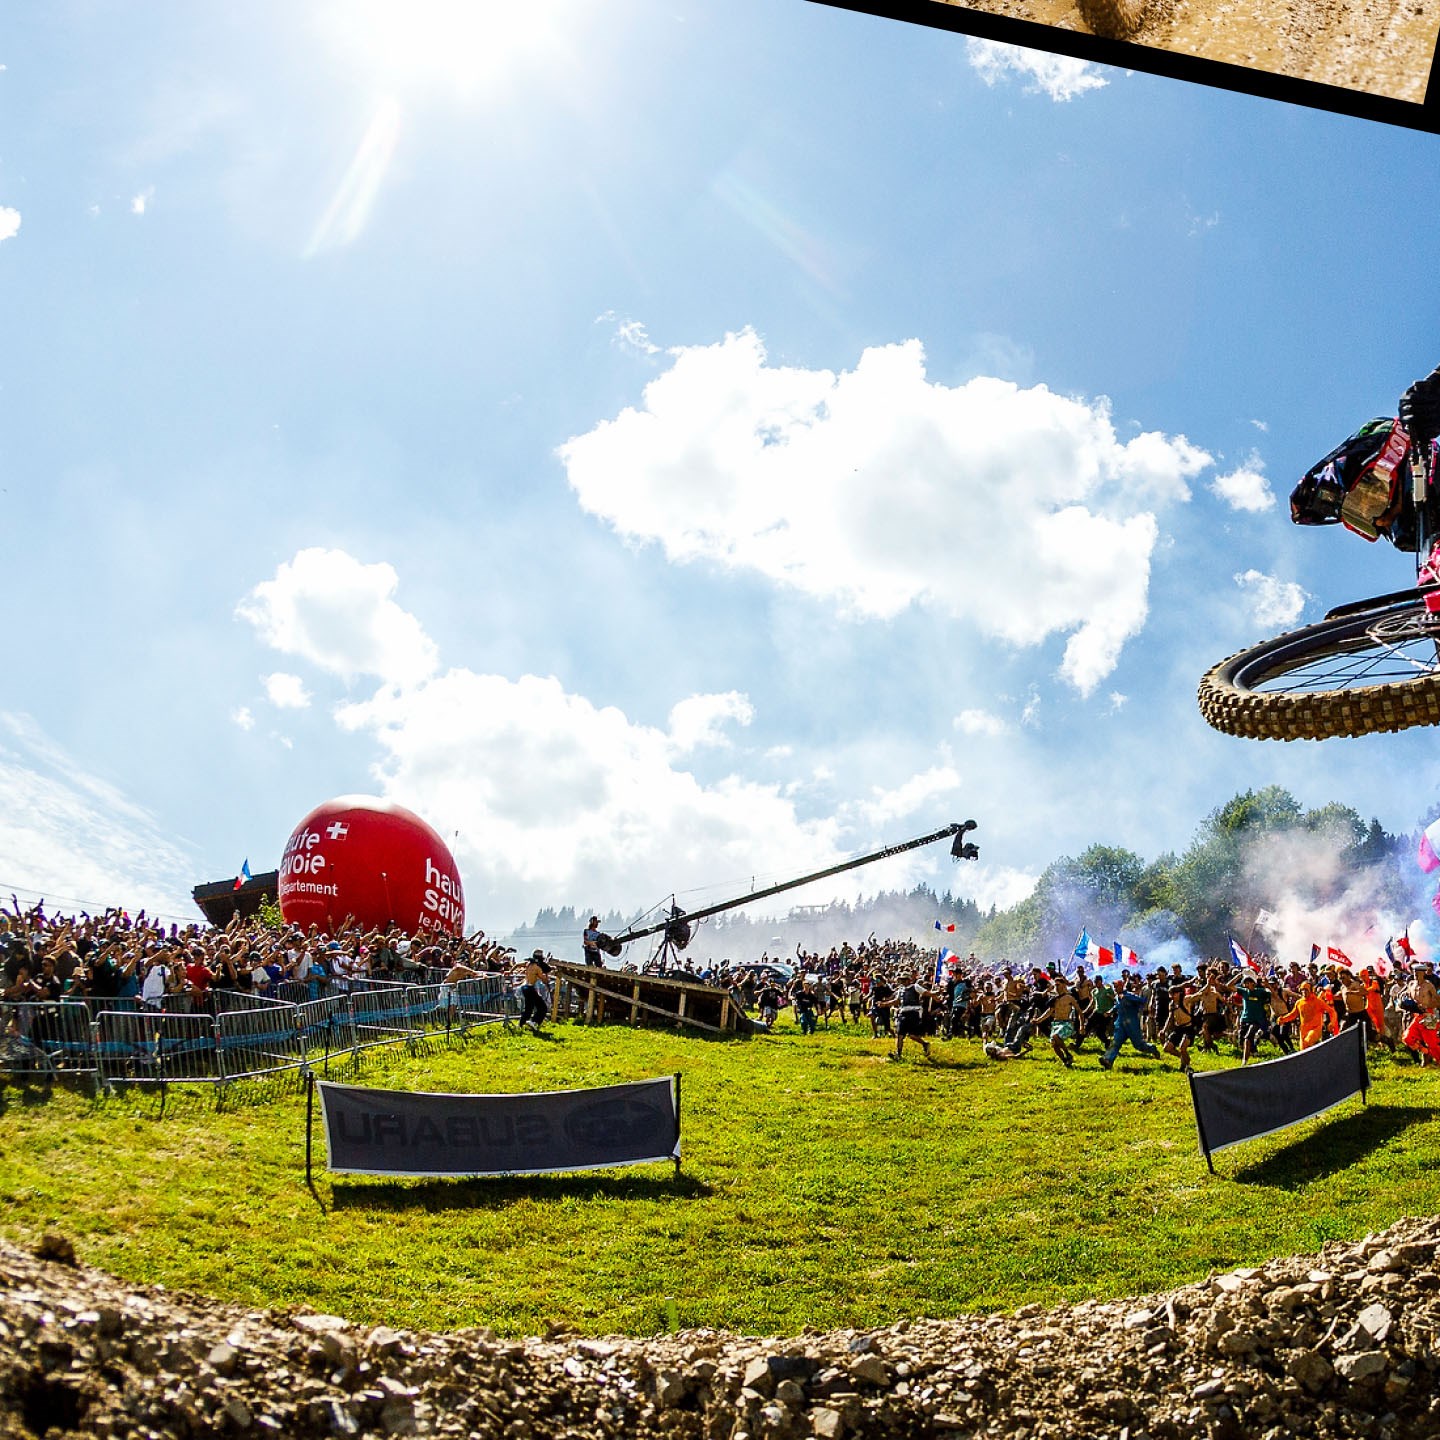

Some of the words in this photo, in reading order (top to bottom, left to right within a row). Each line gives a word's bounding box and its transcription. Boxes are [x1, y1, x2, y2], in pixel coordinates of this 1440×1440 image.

[284, 827, 320, 854] aute
[280, 853, 326, 878] avoie
[425, 857, 464, 903] hau
